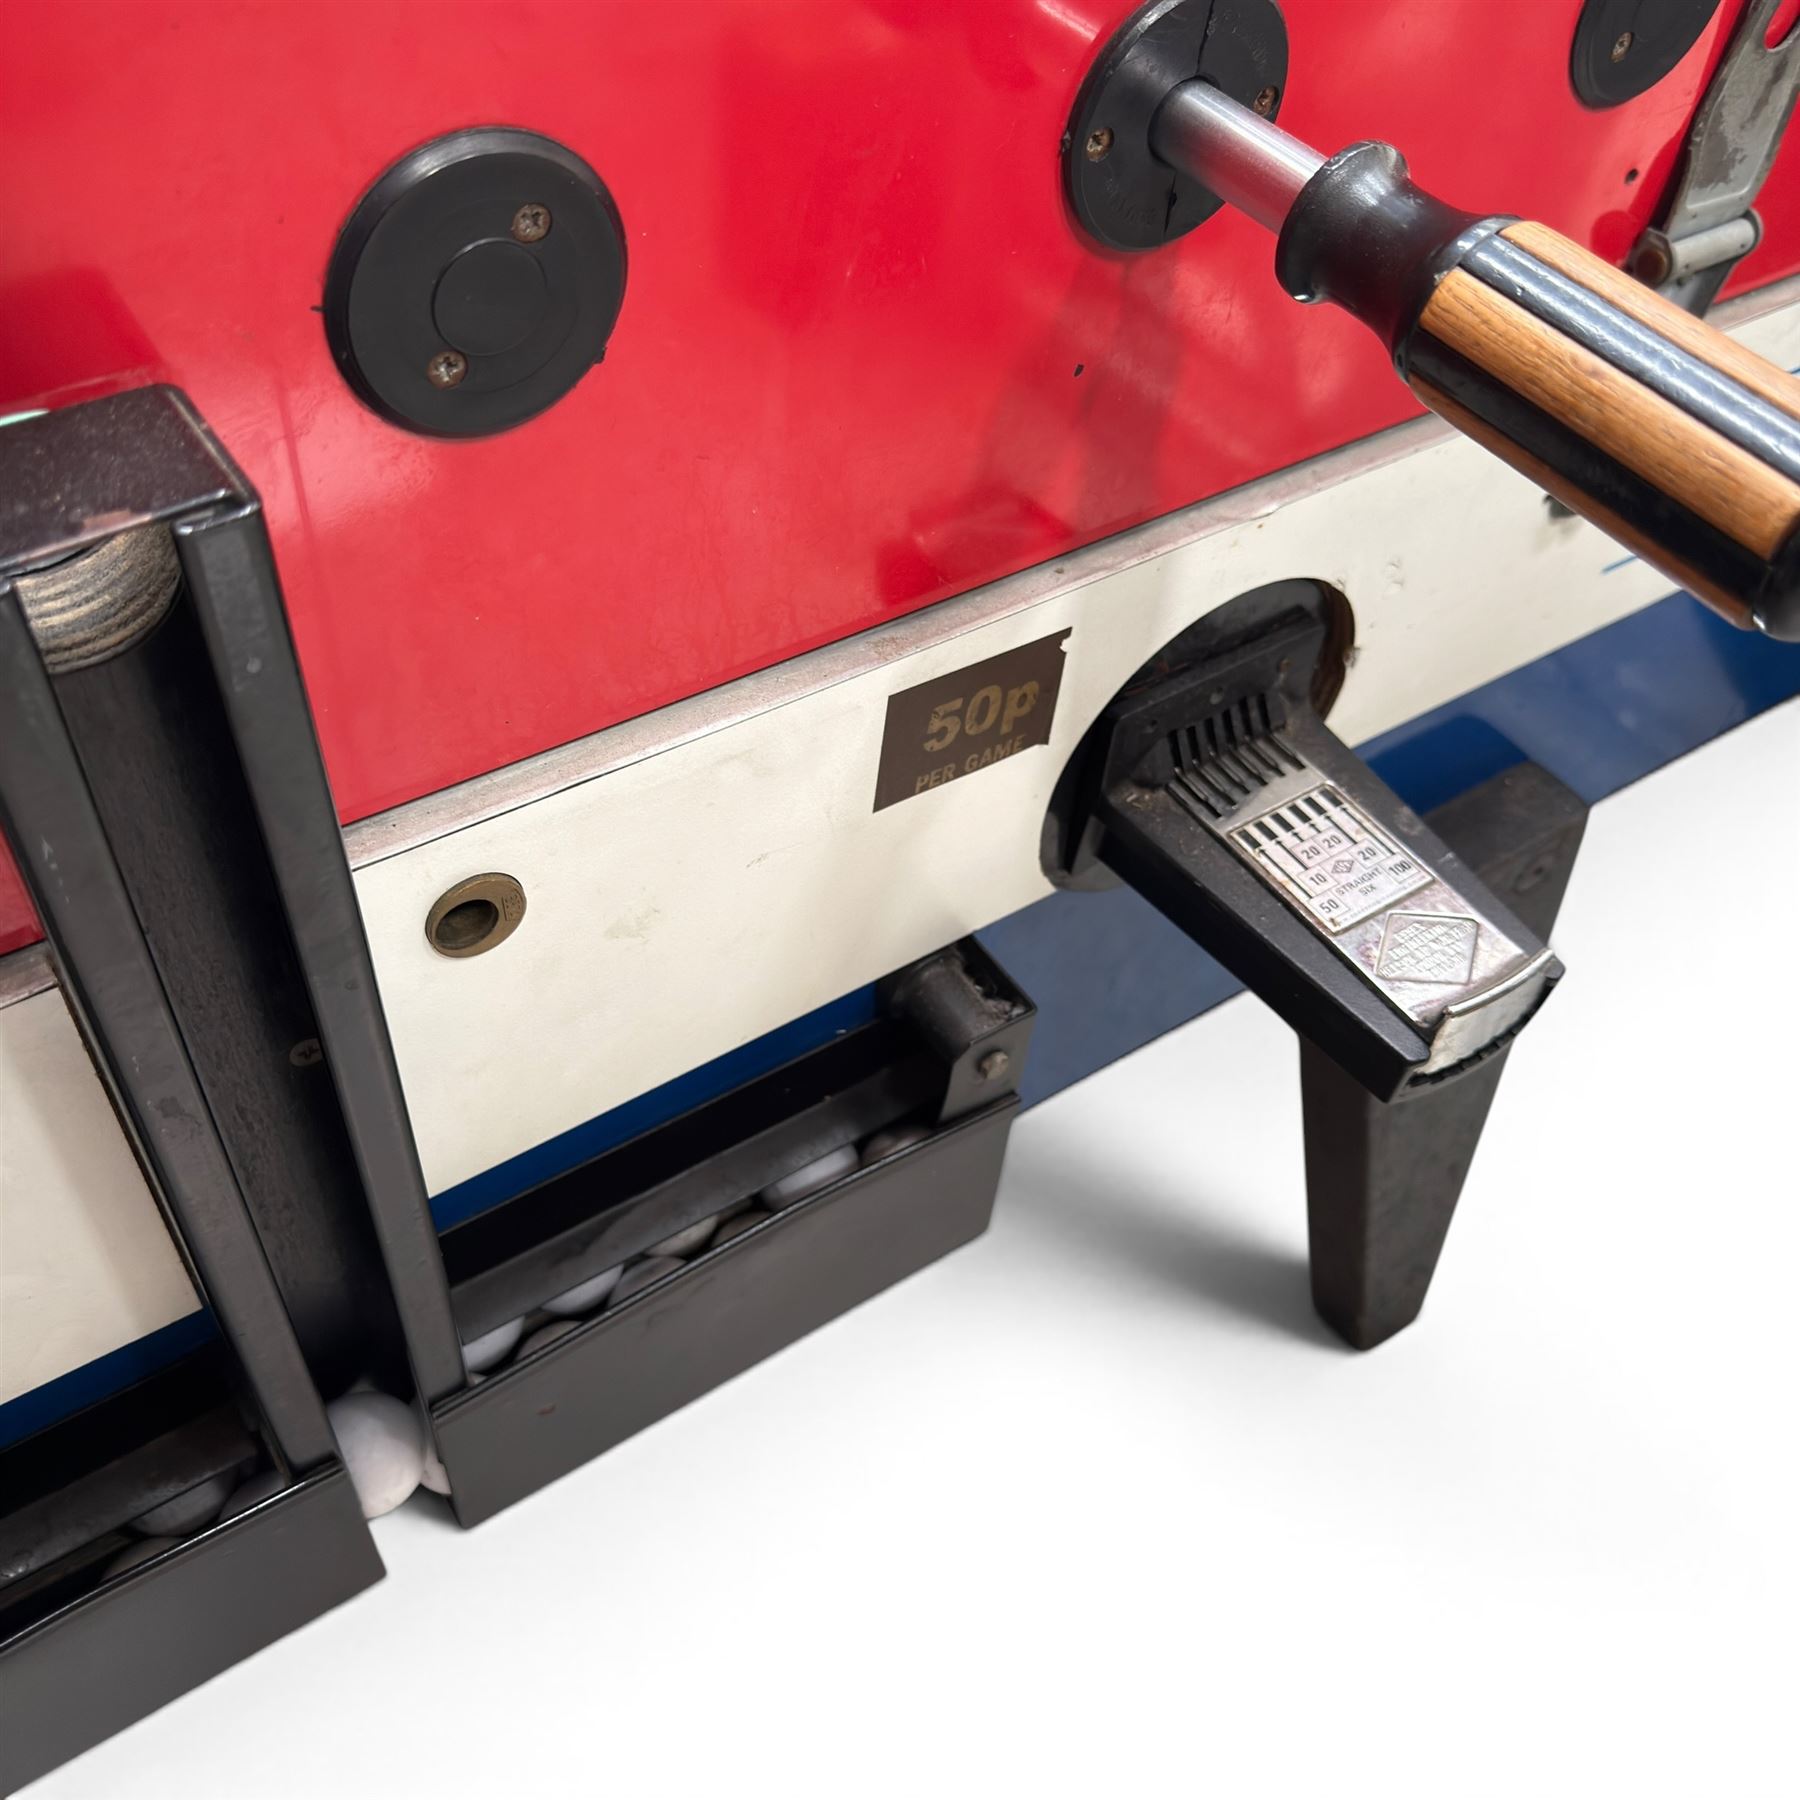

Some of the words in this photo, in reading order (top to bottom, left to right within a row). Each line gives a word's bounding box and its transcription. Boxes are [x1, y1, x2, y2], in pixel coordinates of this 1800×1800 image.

[923, 680, 1040, 752] 50p
[915, 763, 956, 793] PER
[964, 733, 1027, 772] GAME
[1301, 845, 1321, 860] 20
[1322, 834, 1342, 848] 20
[1357, 846, 1377, 861] 20
[1388, 860, 1412, 876] 100
[1309, 872, 1328, 886] 10
[1335, 867, 1383, 895] STRAIGHT
[1358, 884, 1377, 896] SIX
[1319, 899, 1340, 914] 50
